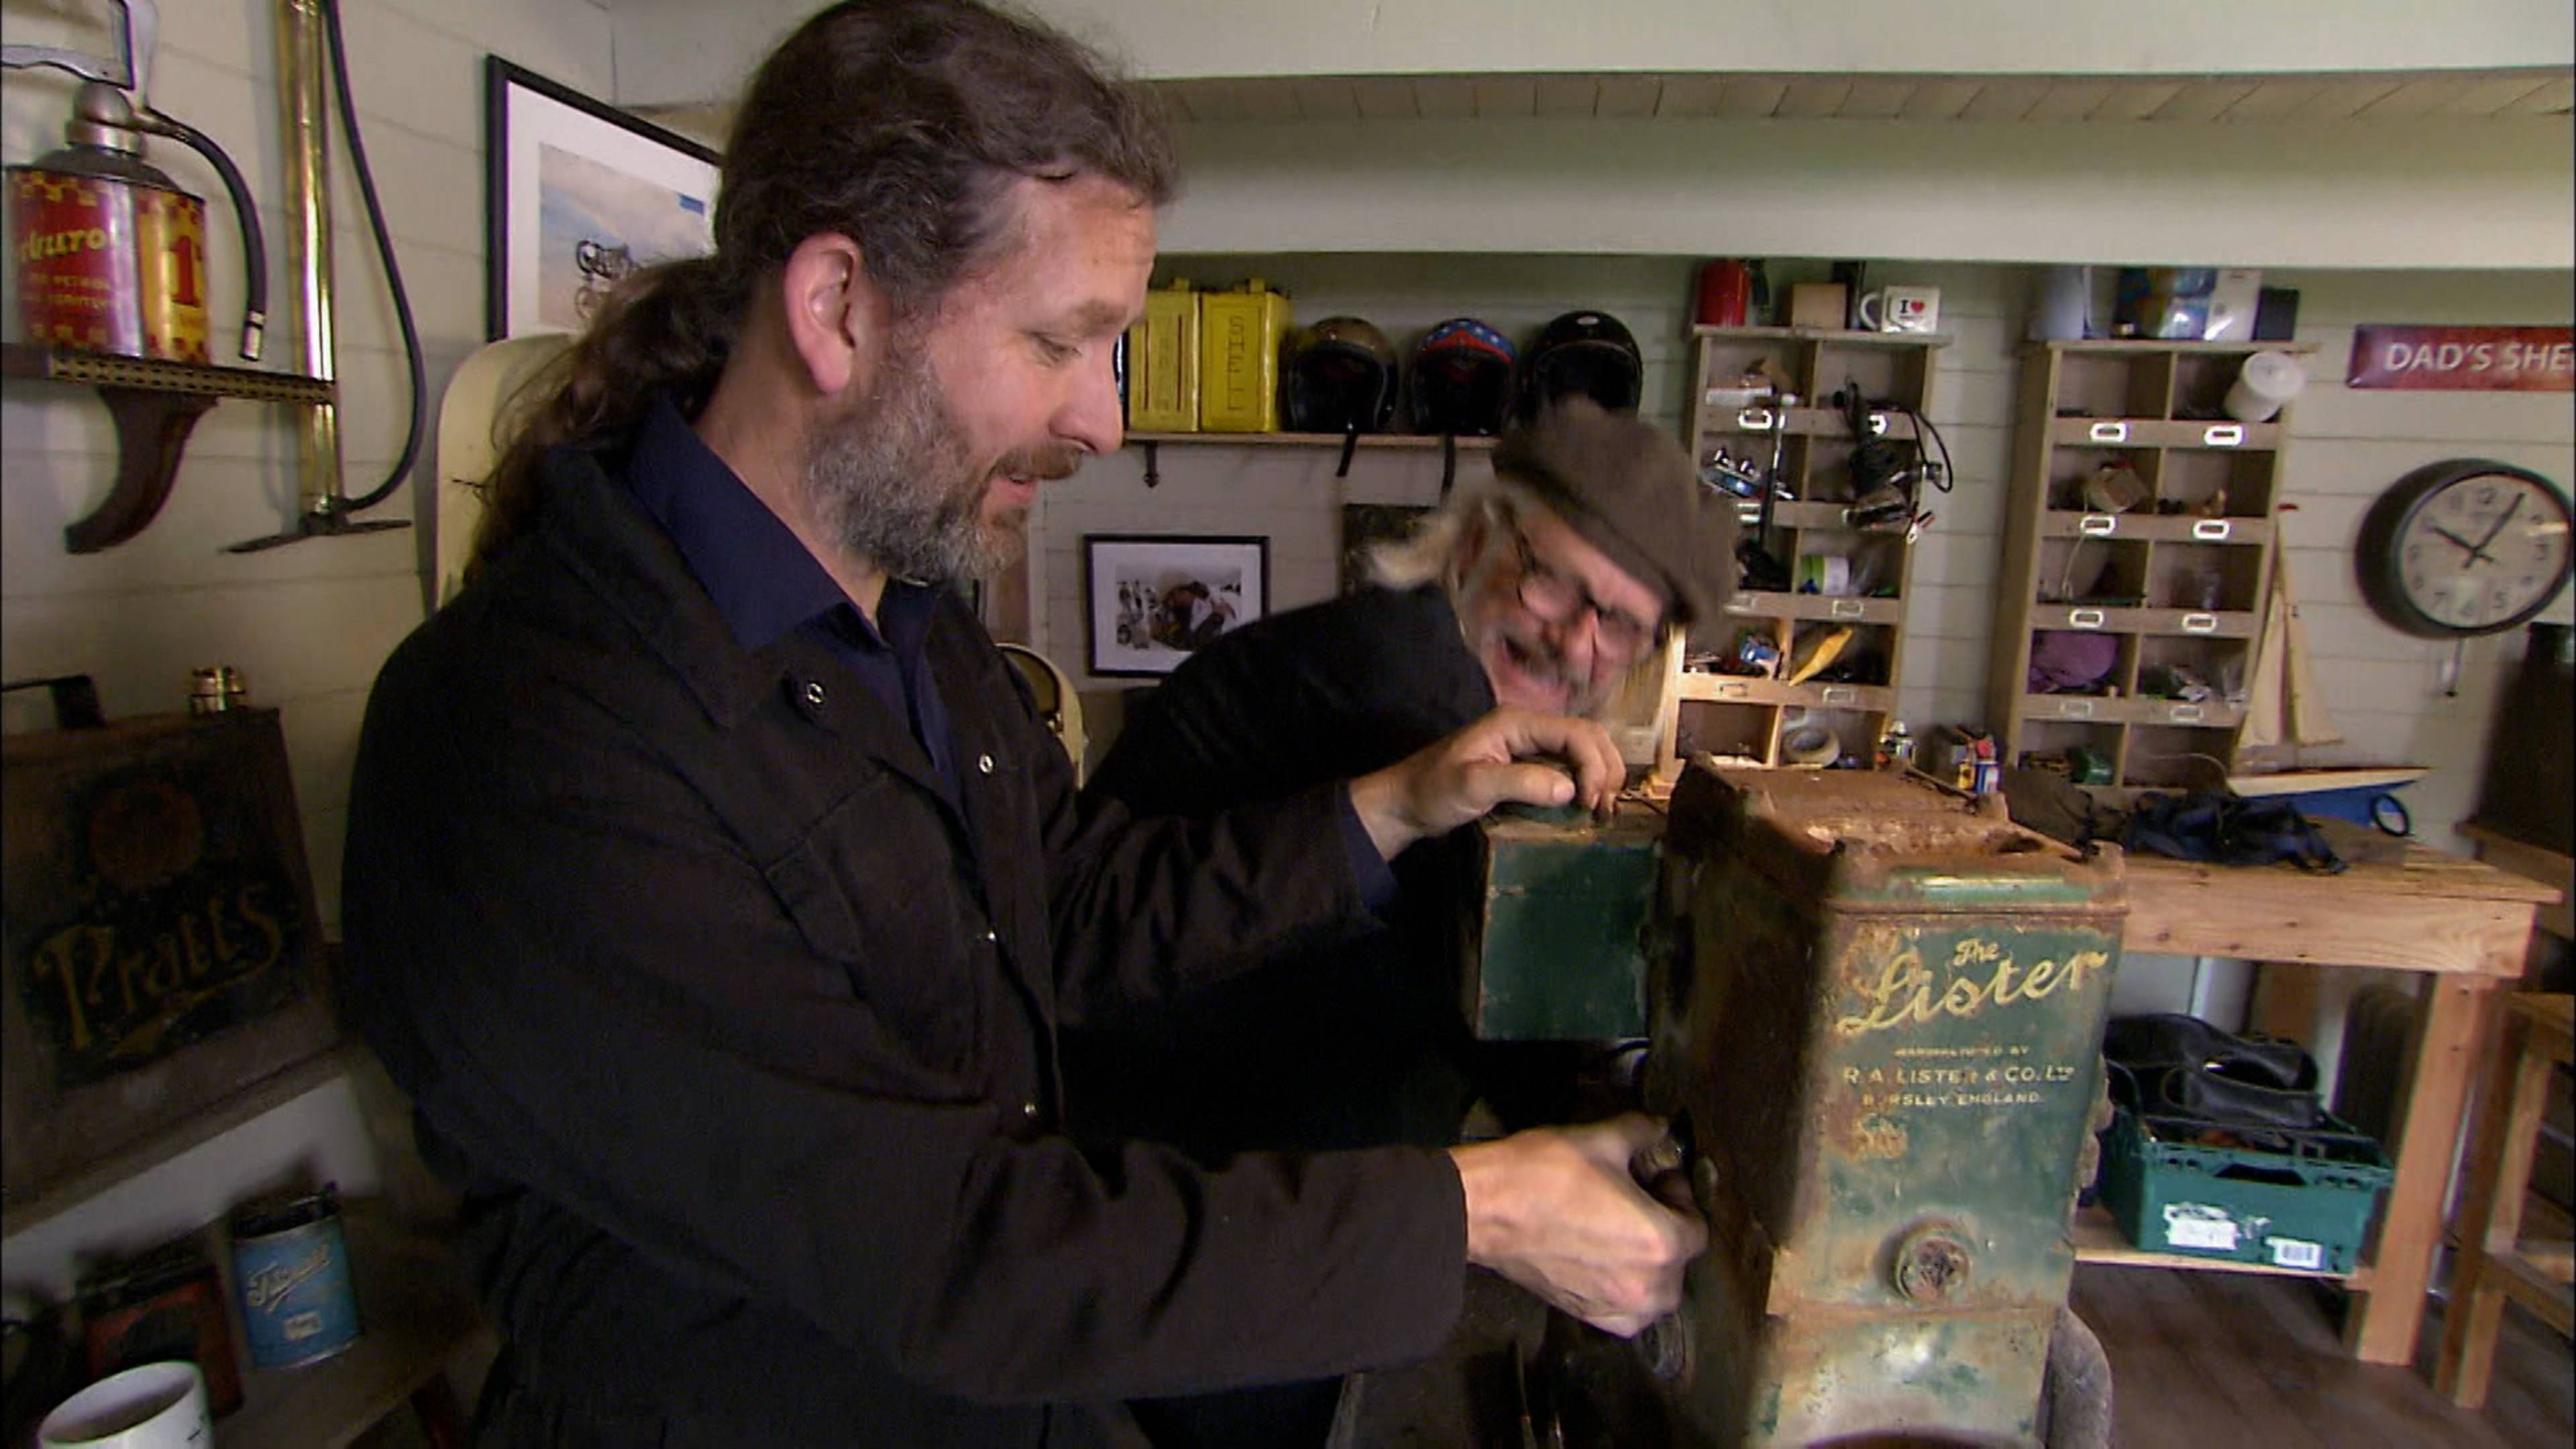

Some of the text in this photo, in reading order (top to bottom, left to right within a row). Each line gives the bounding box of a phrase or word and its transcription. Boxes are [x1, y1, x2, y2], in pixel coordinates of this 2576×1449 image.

[1227, 315, 1245, 411] SHELL
[2385, 342, 2493, 370] DAD'S
[1953, 939, 1999, 967] The
[1837, 950, 2108, 1035] Lister
